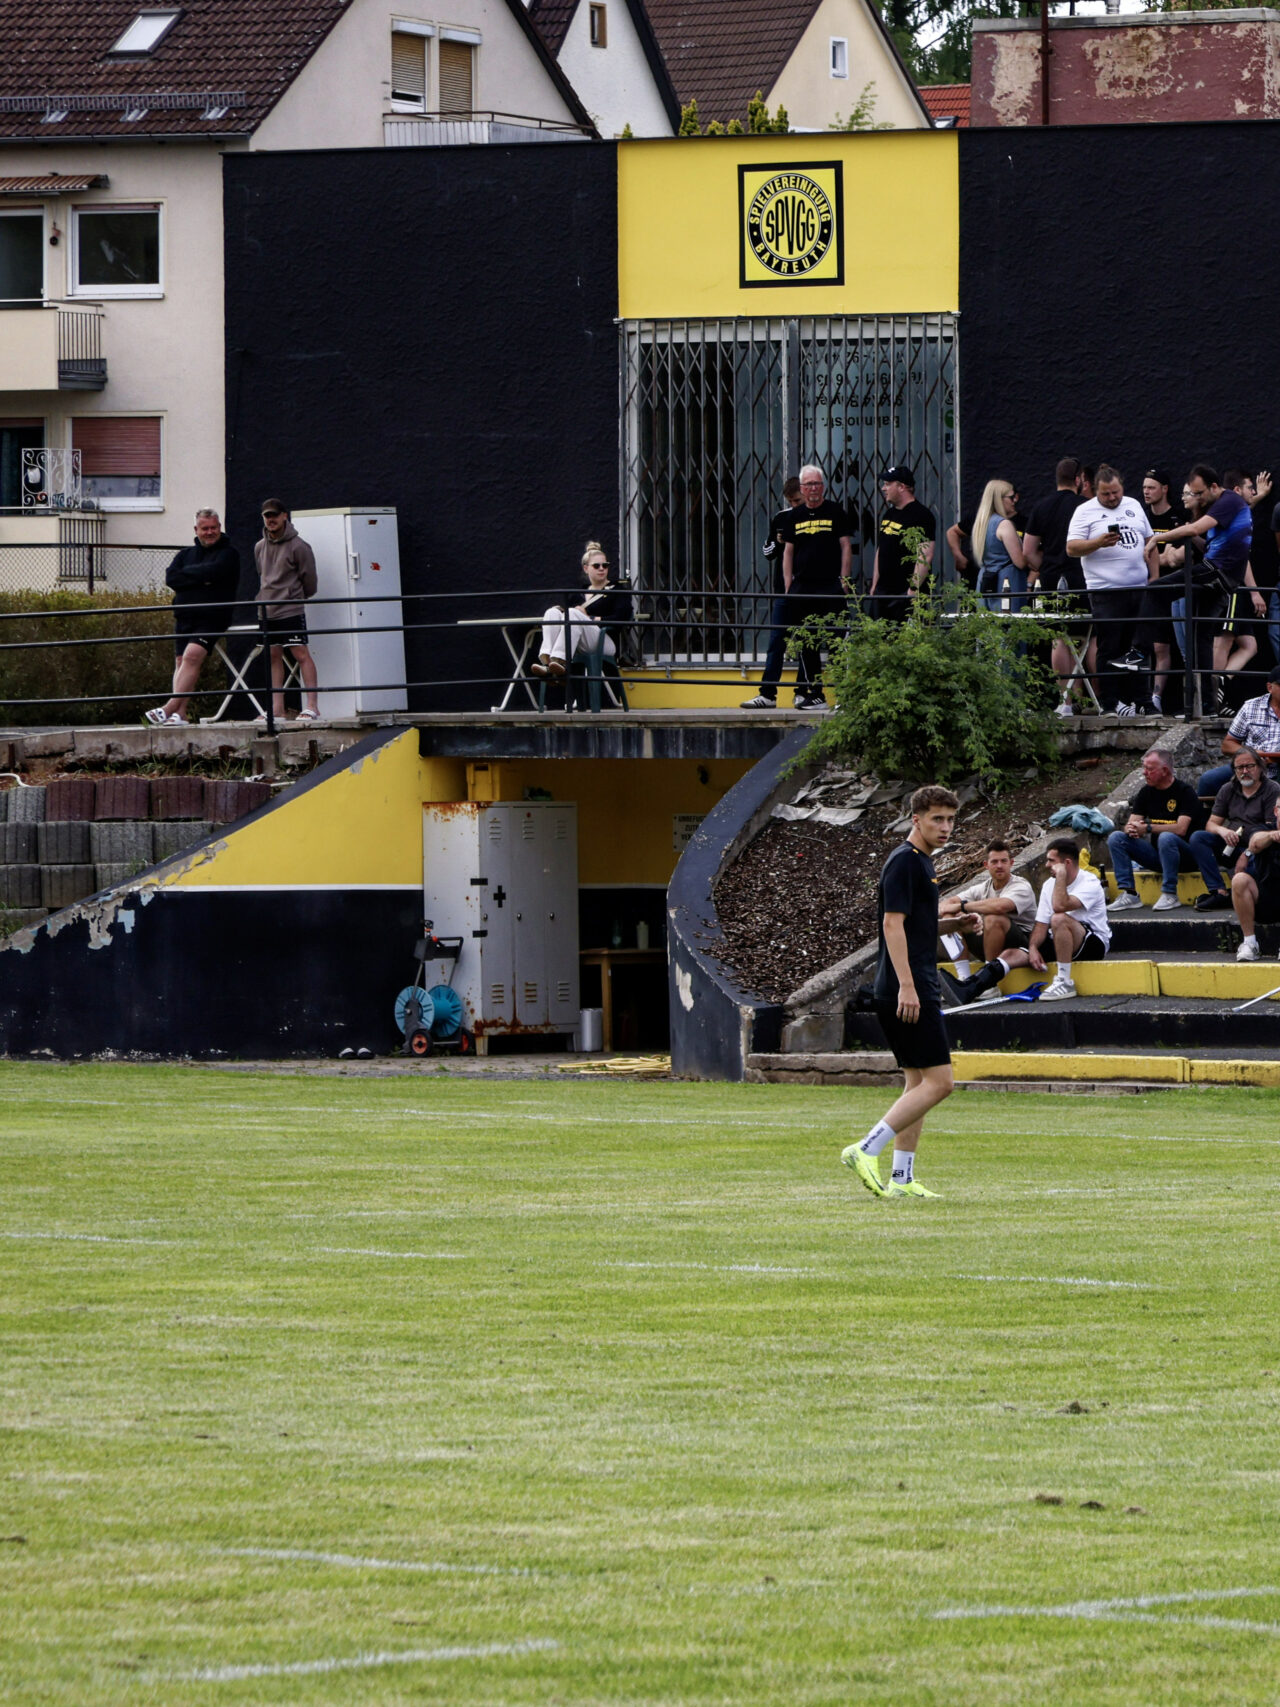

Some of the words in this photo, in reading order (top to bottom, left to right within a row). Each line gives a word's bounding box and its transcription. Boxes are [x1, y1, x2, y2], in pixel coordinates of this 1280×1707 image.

[749, 175, 831, 225] SPIELVEREINIGUNG
[765, 195, 815, 255] SPVGG
[755, 240, 827, 273] BAYREUTH
[821, 416, 901, 429] Banostr.
